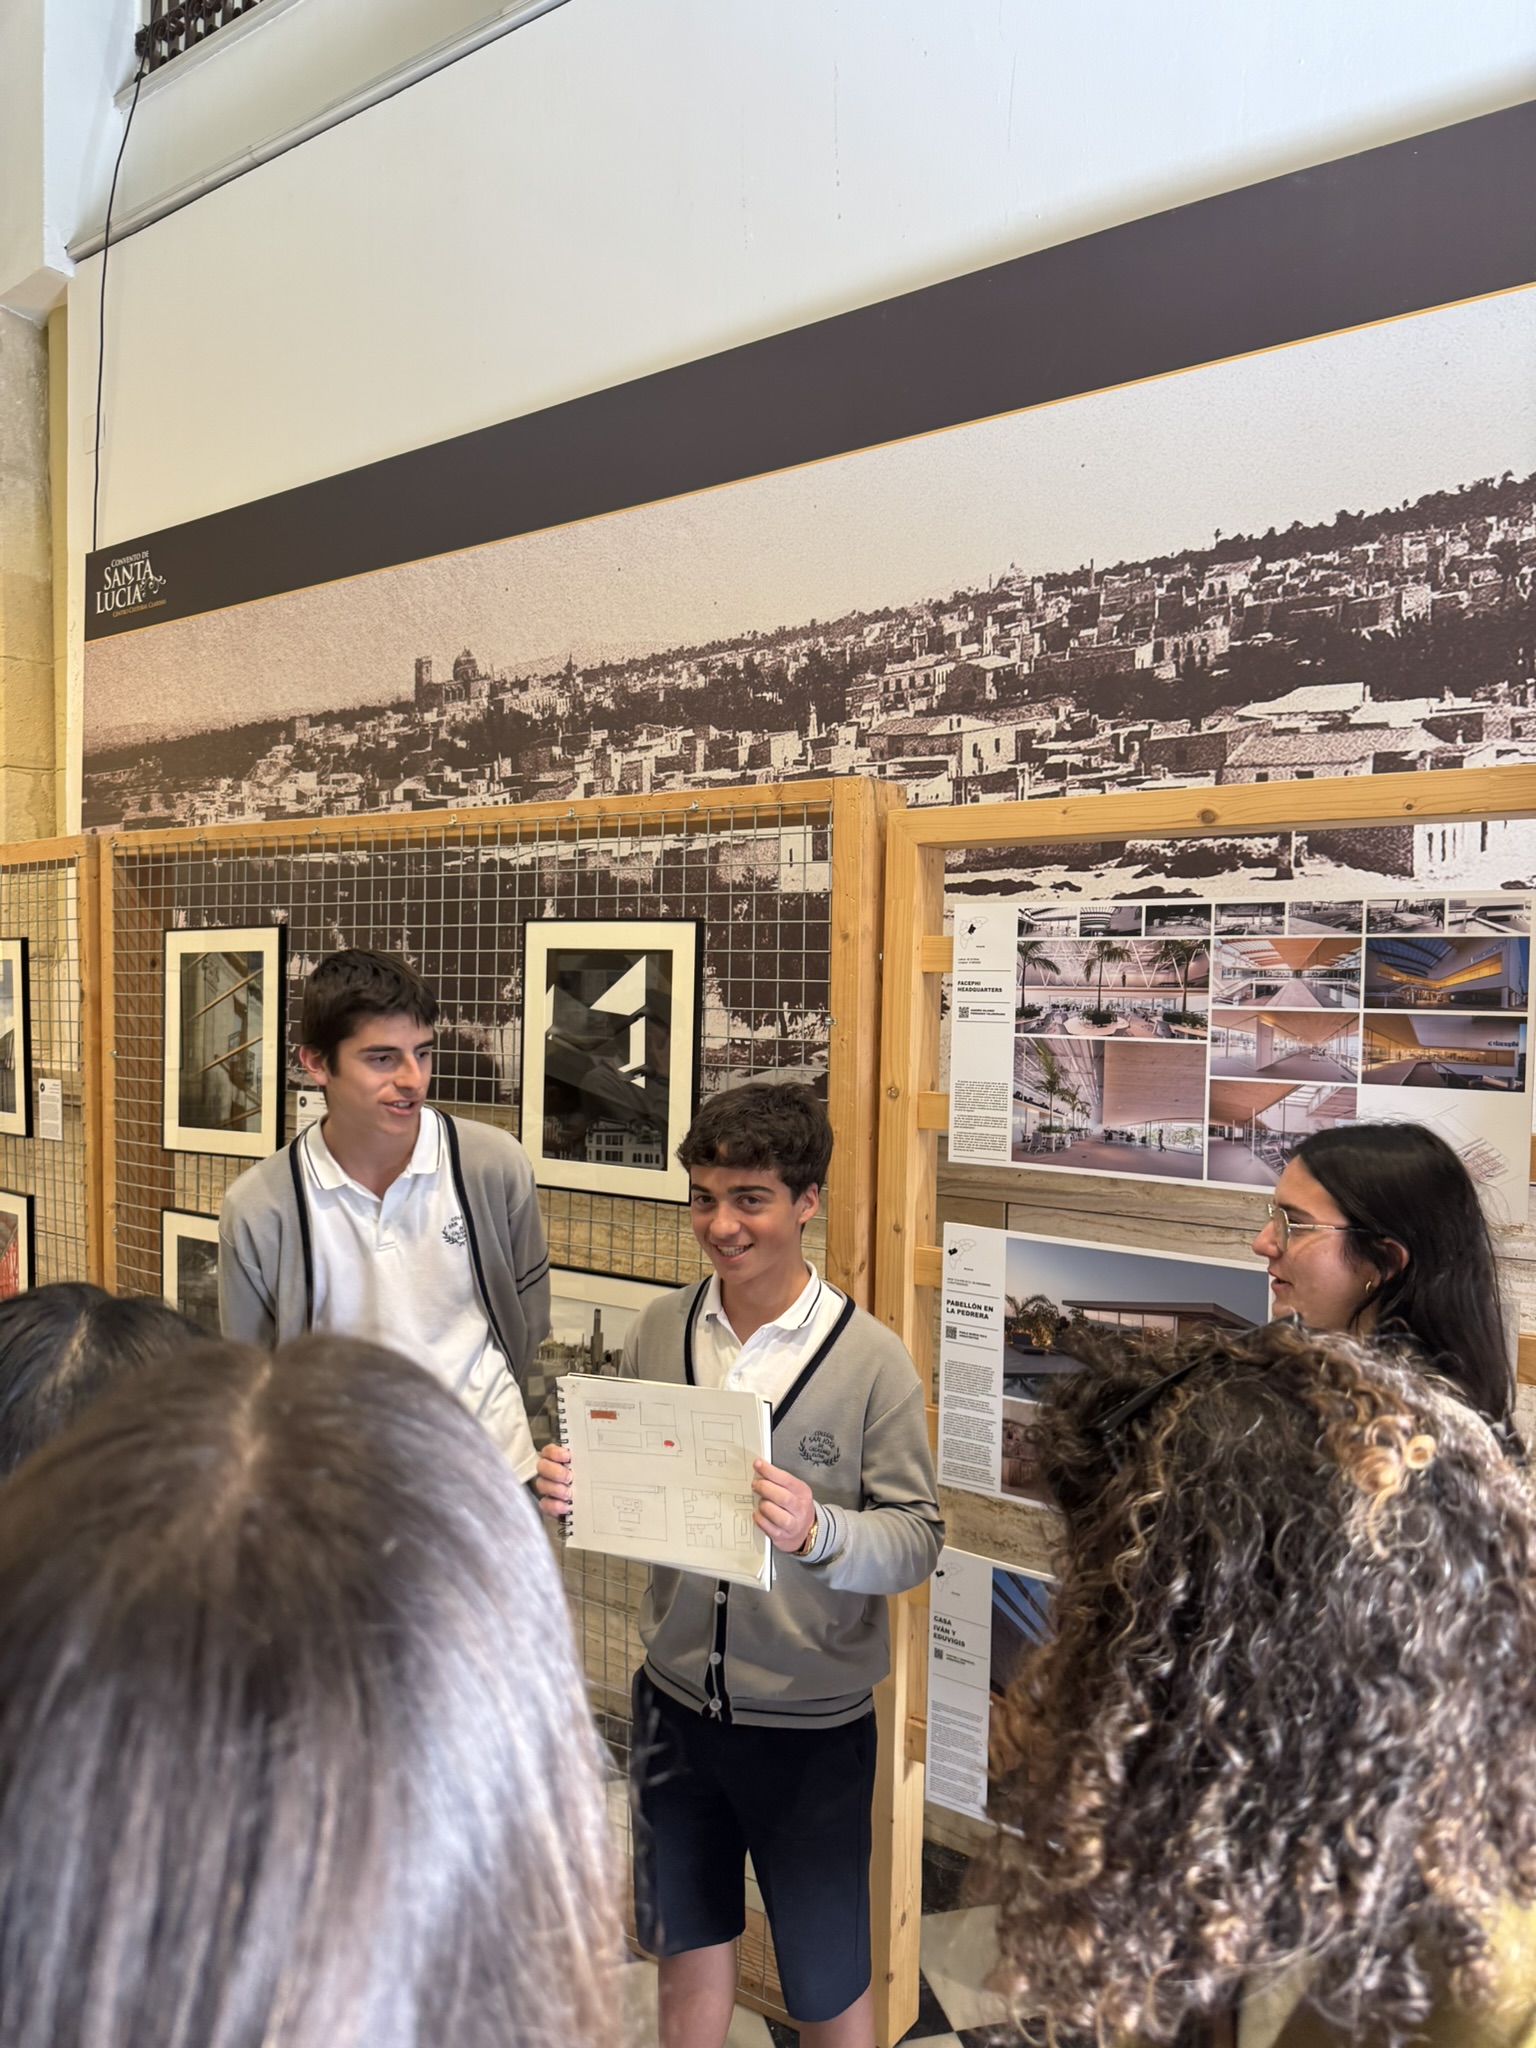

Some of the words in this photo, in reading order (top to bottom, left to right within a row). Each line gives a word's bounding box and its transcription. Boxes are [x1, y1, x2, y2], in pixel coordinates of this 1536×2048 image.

[111, 553, 141, 568] CONVENTO
[141, 550, 150, 559] DE
[104, 559, 154, 591] SANTA
[96, 577, 143, 614] LUCÍA
[946, 1299, 982, 1311] PABELLÓN
[946, 1307, 955, 1315] LA
[957, 1309, 989, 1320] PEDRERA
[933, 1615, 952, 1626] CASA
[933, 1624, 950, 1635] IVÁN
[933, 1632, 966, 1648] EDUVIGIS
